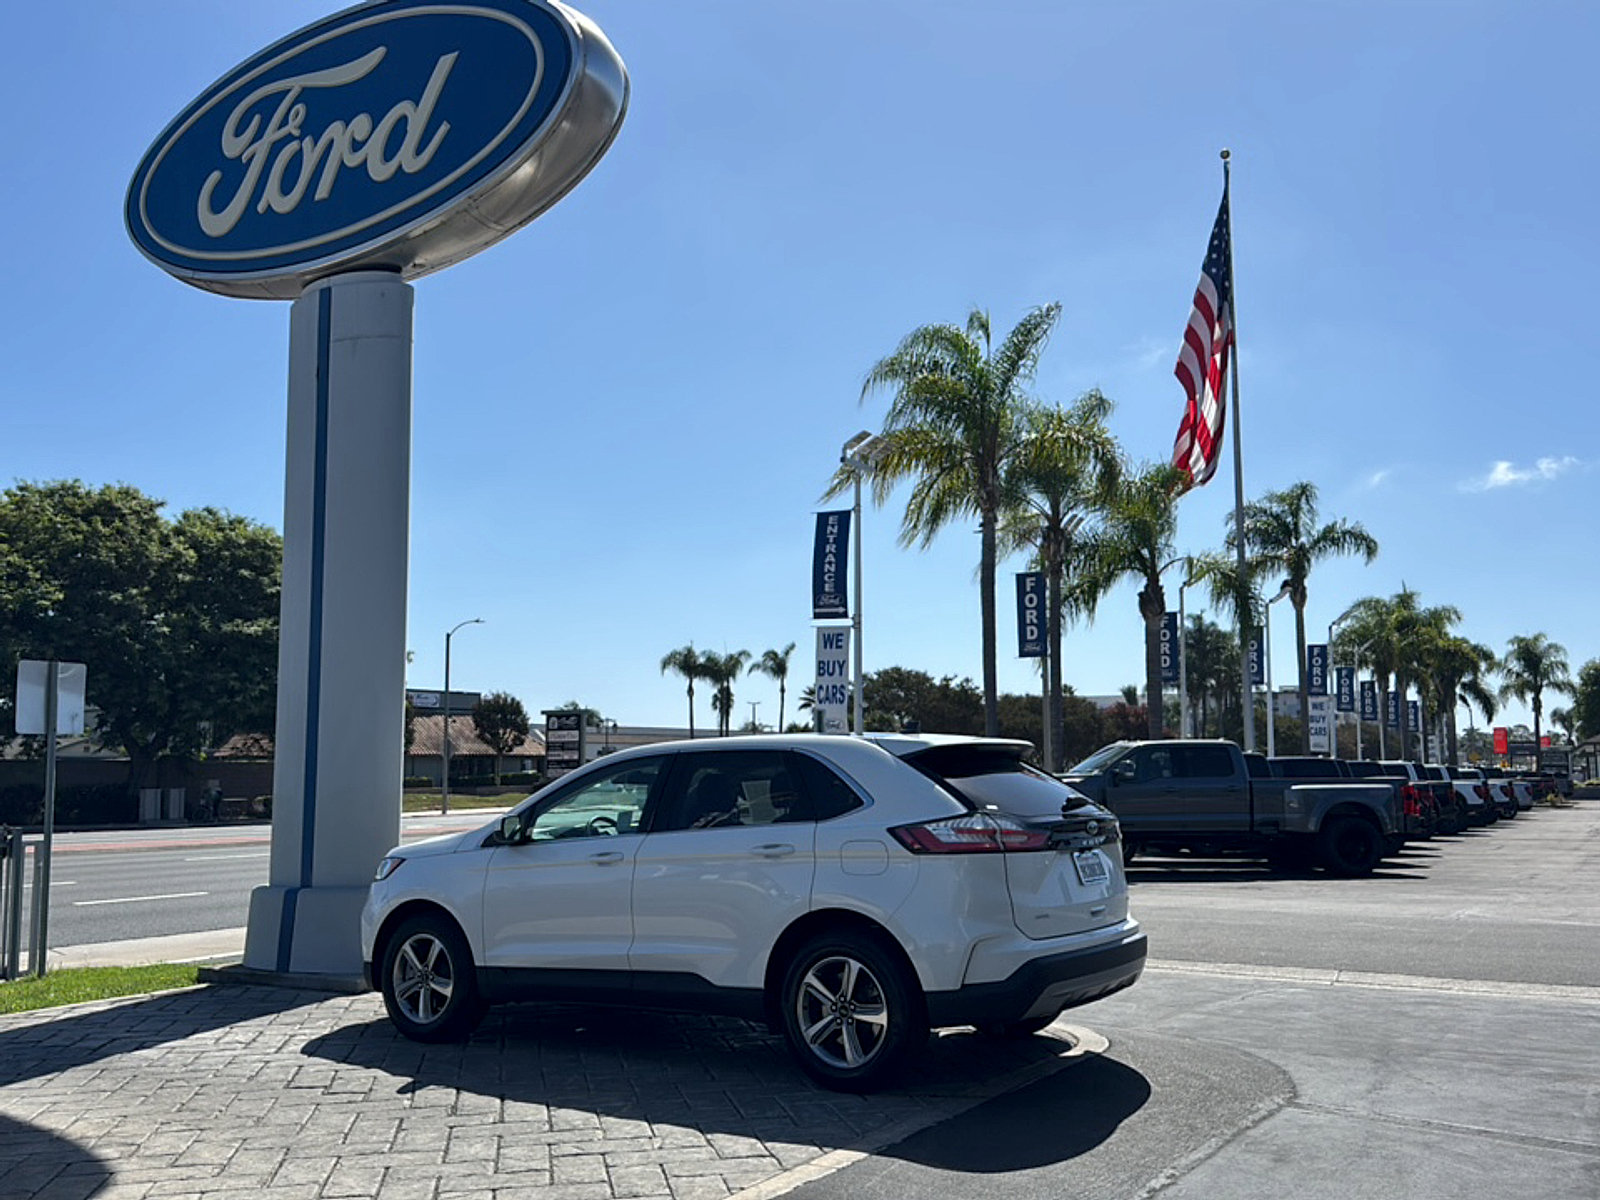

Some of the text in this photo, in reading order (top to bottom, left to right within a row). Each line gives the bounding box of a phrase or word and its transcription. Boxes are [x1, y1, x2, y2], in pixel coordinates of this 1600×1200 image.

[197, 45, 459, 238] Ford
[824, 515, 838, 592] ENTRANCE
[1025, 577, 1038, 640] FORD
[823, 633, 844, 649] WE
[818, 660, 846, 676] BUY
[1312, 647, 1321, 686] FORD
[817, 683, 846, 705] CARS
[1341, 668, 1349, 703] FORD
[1312, 702, 1324, 711] WE
[1310, 715, 1326, 724] BUY
[1310, 727, 1327, 736] CARS
